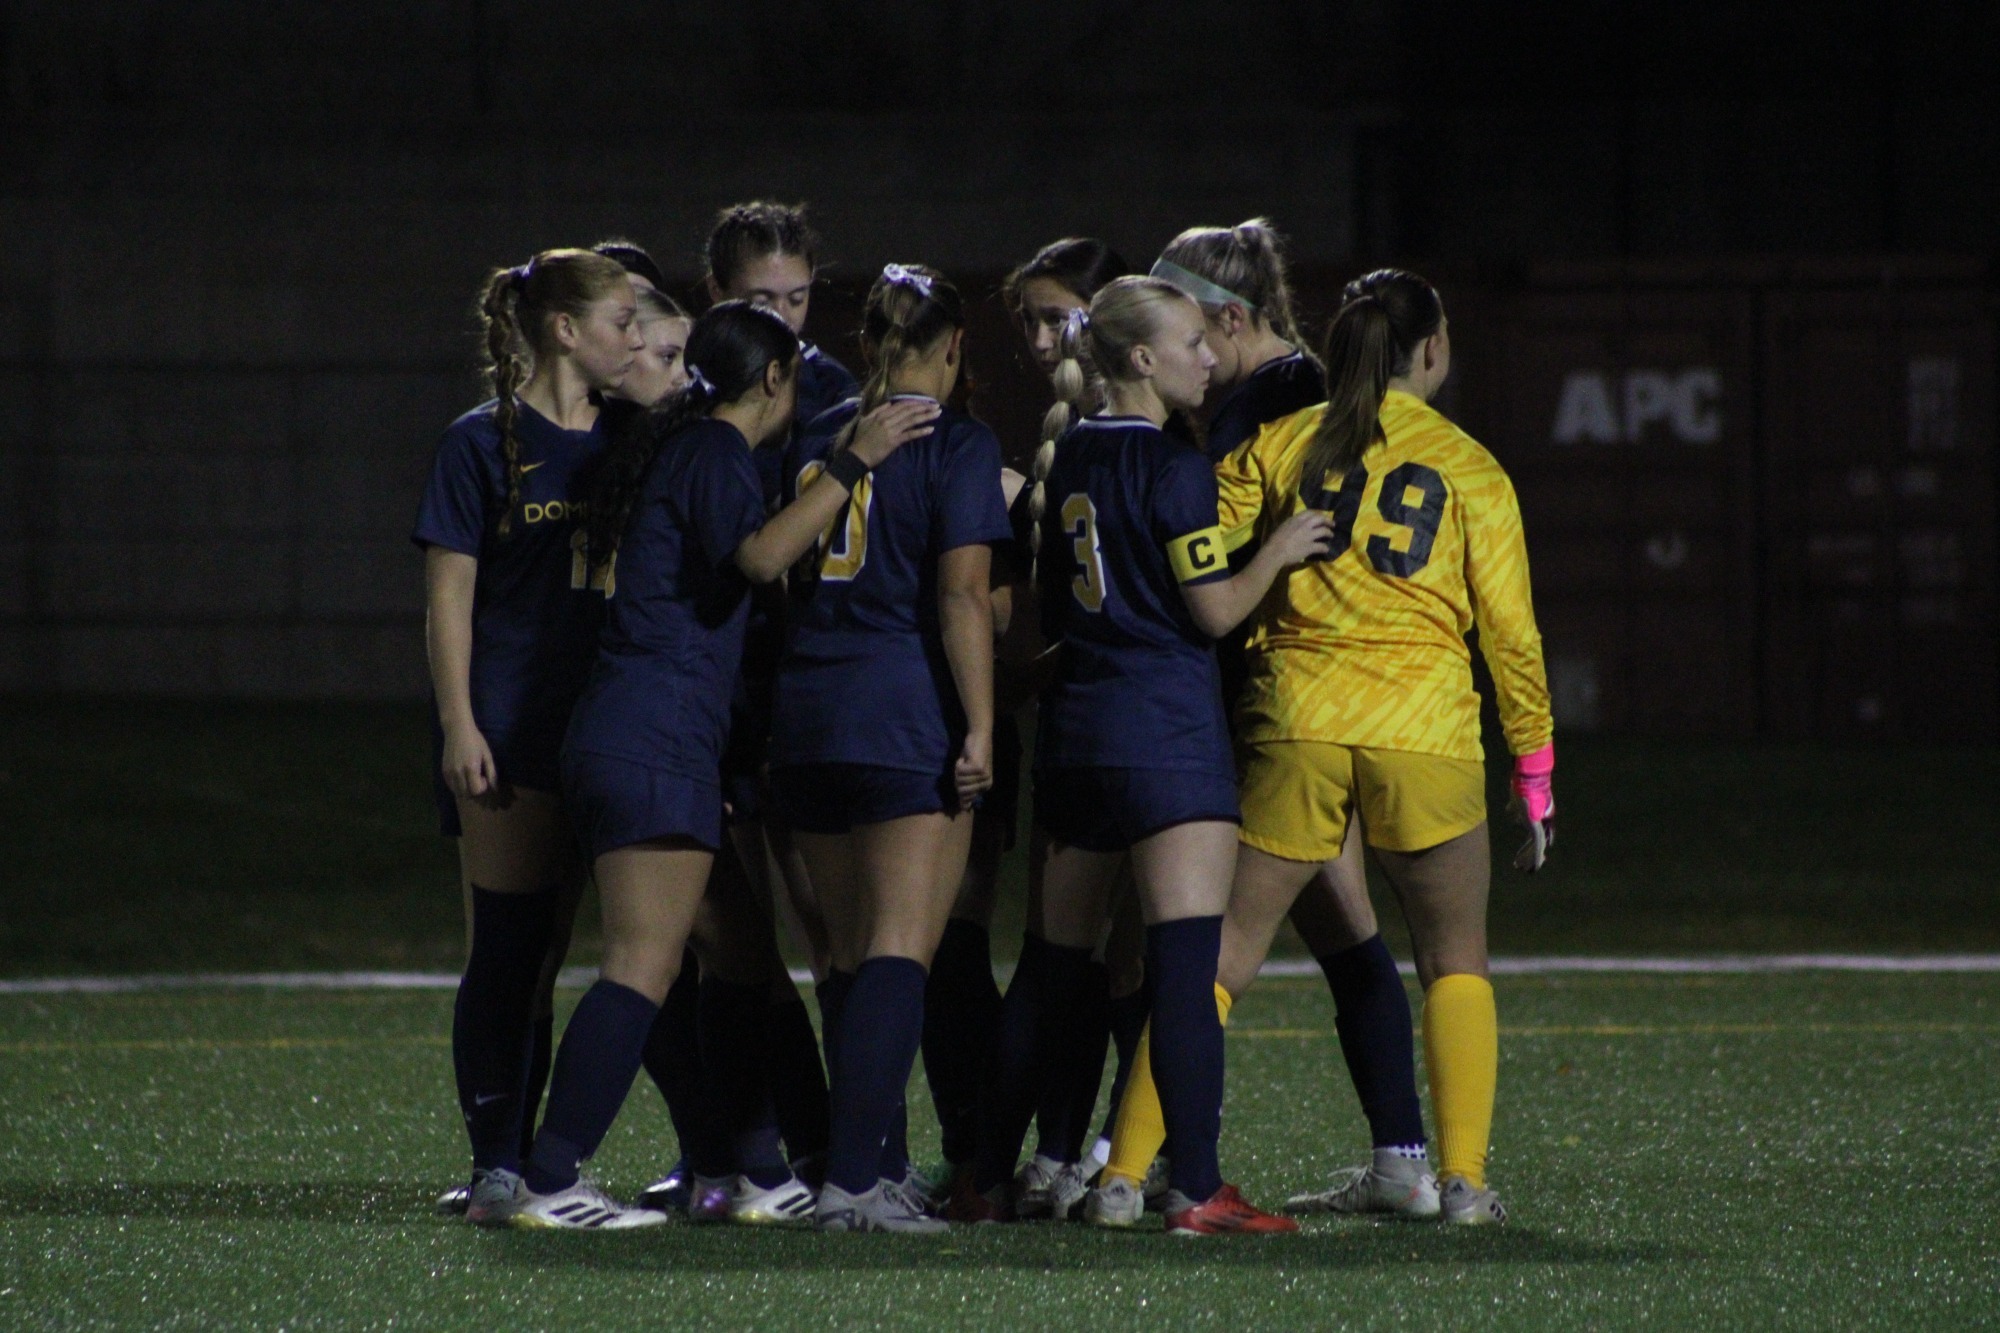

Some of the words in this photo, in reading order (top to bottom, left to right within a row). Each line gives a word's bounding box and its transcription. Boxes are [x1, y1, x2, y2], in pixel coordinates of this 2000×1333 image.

[1553, 366, 1724, 444] APC
[1060, 492, 1107, 614] 3
[1186, 535, 1216, 570] C
[1299, 461, 1448, 578] 99
